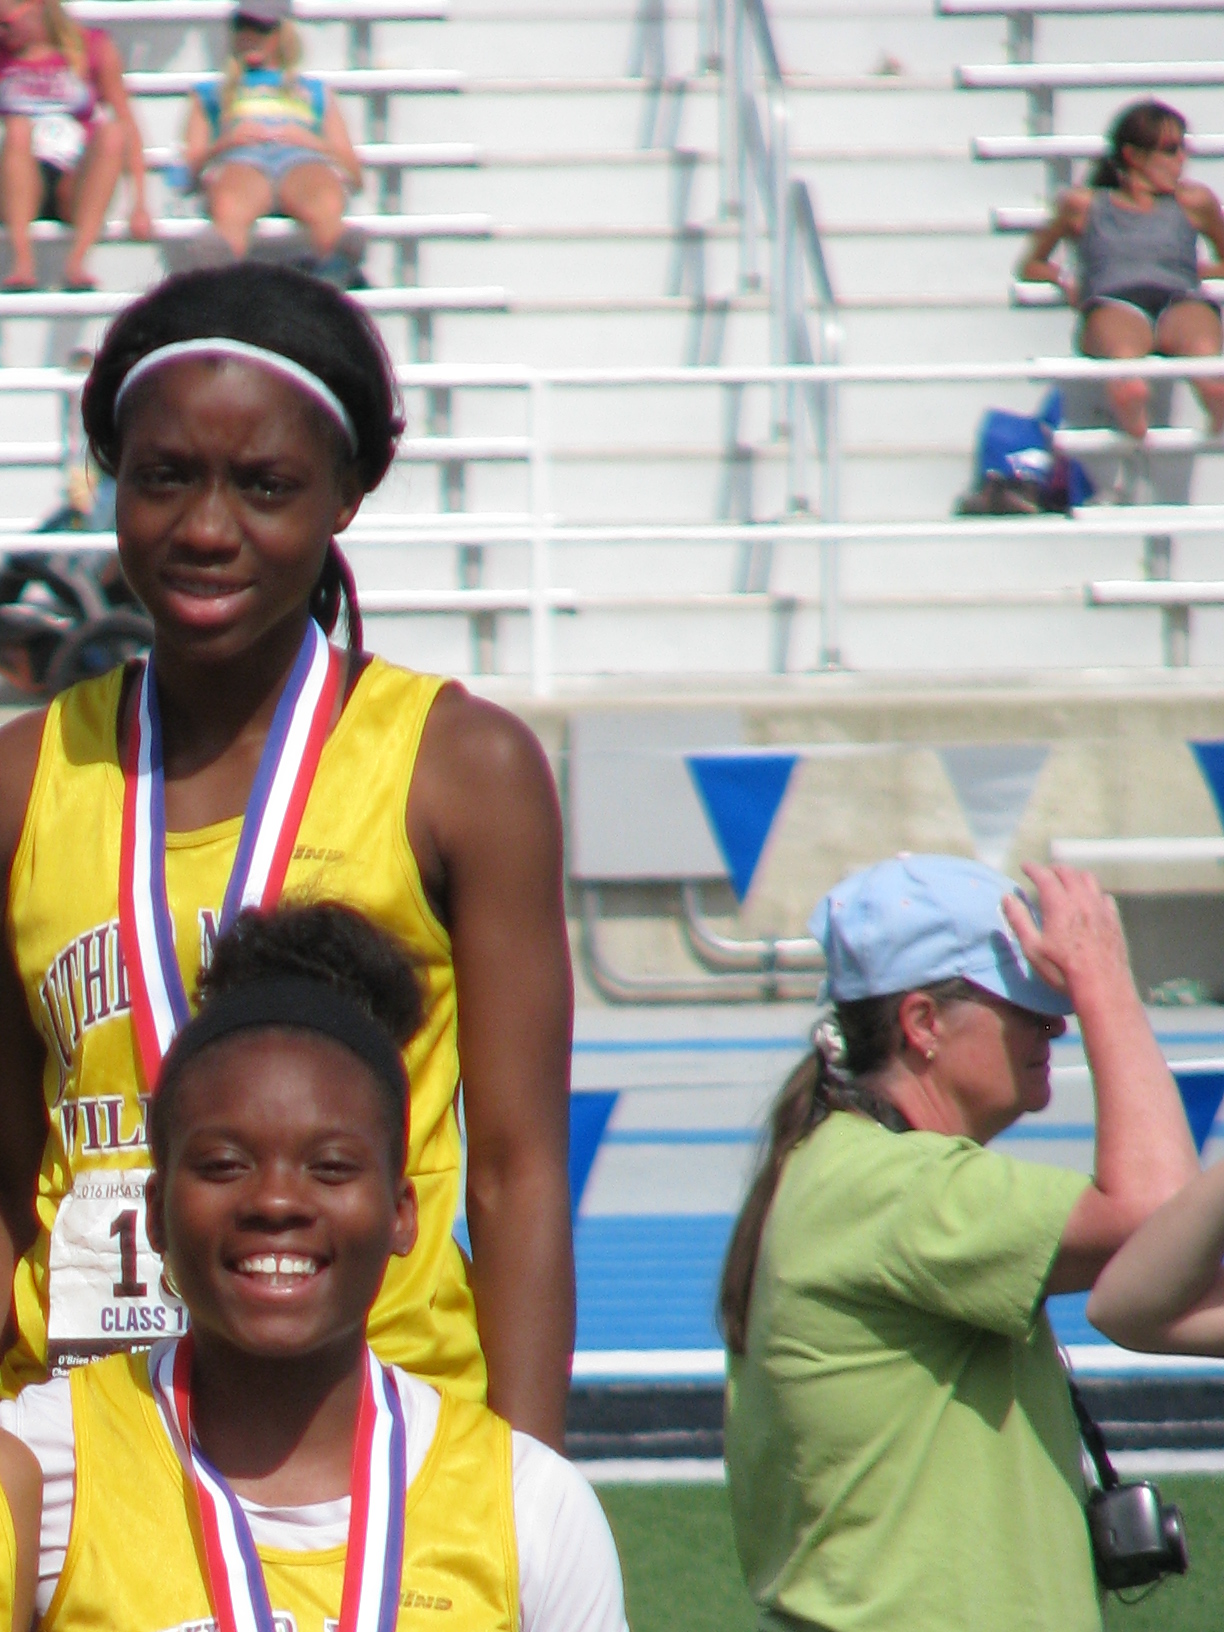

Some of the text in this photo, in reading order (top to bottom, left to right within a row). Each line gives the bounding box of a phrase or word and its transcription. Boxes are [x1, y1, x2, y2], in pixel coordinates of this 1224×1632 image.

[293, 845, 345, 863] IND
[109, 1209, 147, 1297] 1
[101, 1306, 166, 1332] CLASS
[400, 1590, 453, 1611] IND
